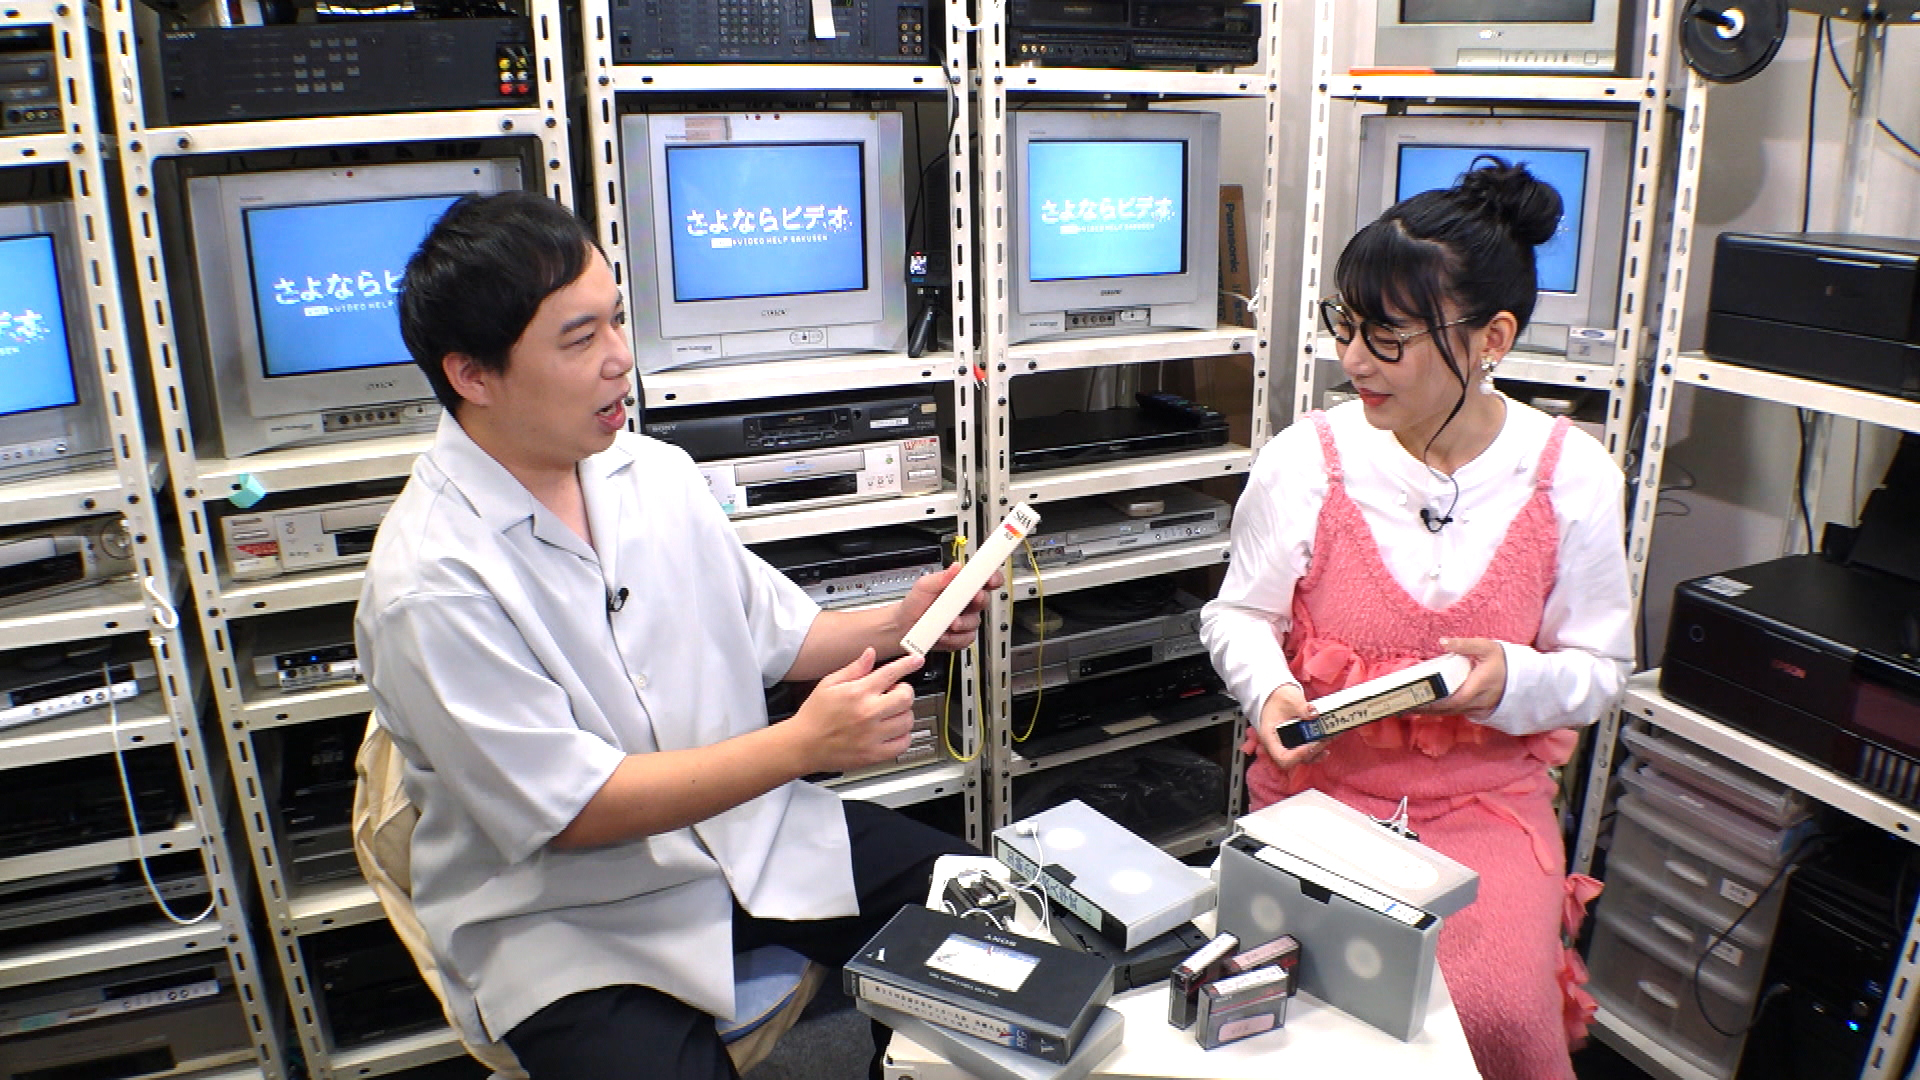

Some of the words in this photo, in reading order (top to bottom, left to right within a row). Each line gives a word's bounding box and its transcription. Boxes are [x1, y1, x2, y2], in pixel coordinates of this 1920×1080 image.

[686, 204, 852, 237] さよならビデオ
[1041, 196, 1175, 224] さよならビデオ
[1225, 203, 1238, 273] Panasonic
